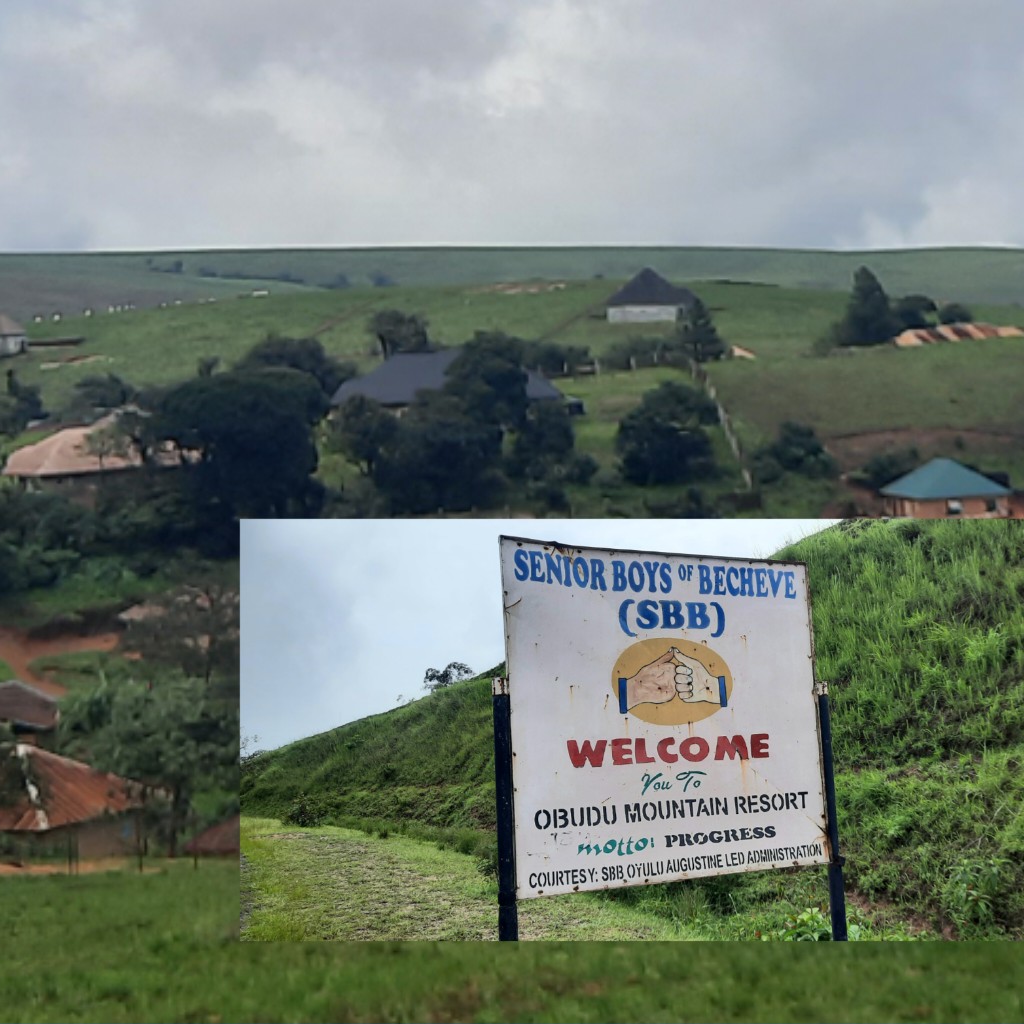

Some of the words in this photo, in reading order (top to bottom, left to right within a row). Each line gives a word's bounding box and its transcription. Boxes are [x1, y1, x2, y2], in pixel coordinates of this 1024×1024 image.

[514, 549, 607, 592] SENIOR
[611, 561, 672, 594] BOYS
[678, 564, 694, 582] OF
[698, 565, 797, 599] BECHEVE
[618, 599, 725, 638] (SBB)
[566, 733, 770, 768] WELCOME
[641, 772, 672, 796] You
[676, 771, 707, 792] To
[534, 804, 617, 830] OBUDU
[624, 797, 728, 824] MOUNTAIN
[734, 791, 809, 815] RESORT
[664, 825, 777, 848] PROGRESS
[529, 867, 599, 889] COURTESY:
[601, 864, 625, 882] SBB
[627, 858, 665, 879] OYULU
[666, 852, 723, 874] AUGUSTINE
[725, 850, 746, 868] LED
[747, 842, 823, 866] ADMINISTRATION
